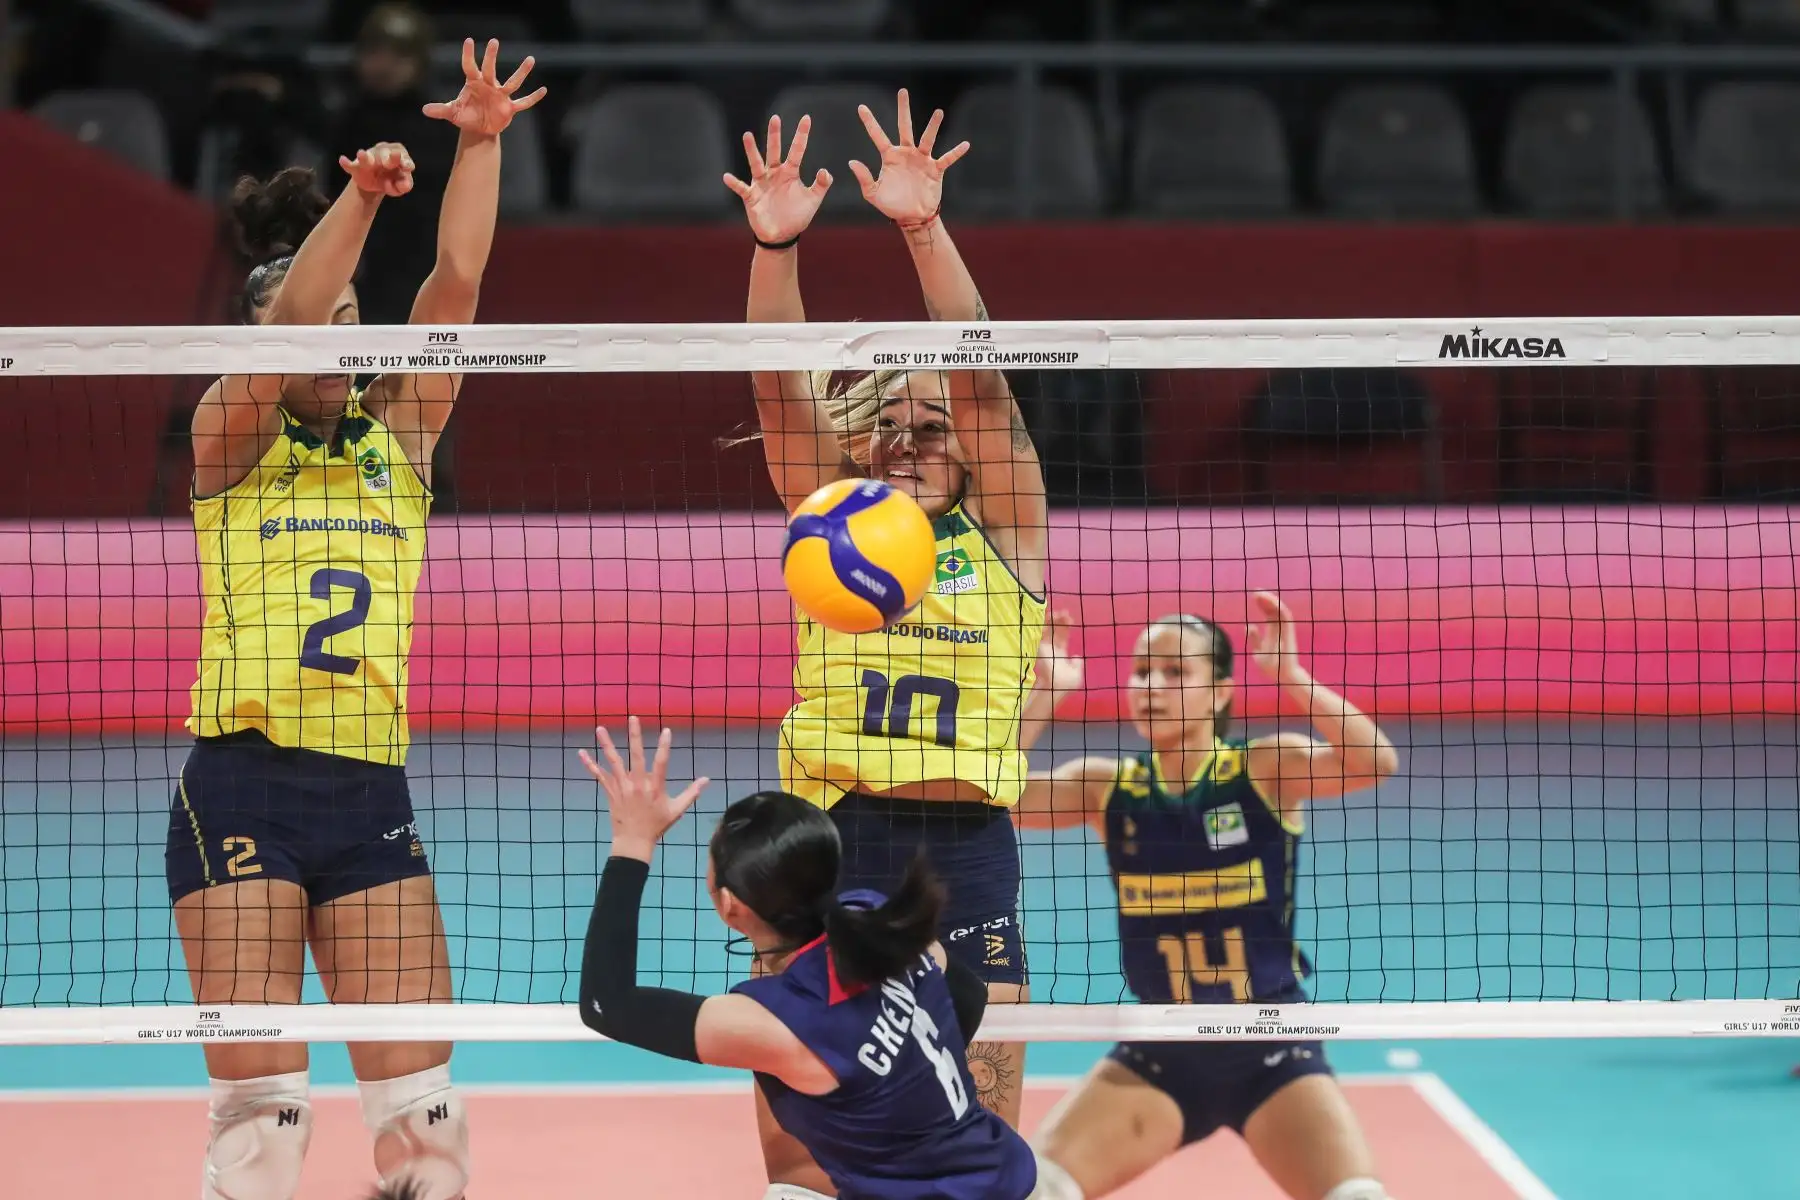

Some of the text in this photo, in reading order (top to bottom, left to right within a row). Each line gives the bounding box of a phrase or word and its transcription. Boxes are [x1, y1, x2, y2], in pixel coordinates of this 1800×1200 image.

[428, 332, 458, 342] FIVB
[961, 329, 992, 340] FIVB
[380, 356, 403, 367] U17
[407, 355, 451, 367] WORLD
[454, 354, 547, 366] CHAMPIONSHIP
[914, 353, 936, 364] U17
[941, 352, 984, 364] WORLD
[987, 352, 1079, 364] CHAMPIONSHIP
[286, 517, 345, 532] BANCO
[348, 519, 369, 534] DO
[937, 575, 978, 594] BRASIL
[300, 567, 372, 675] 2
[912, 625, 934, 639] DO
[937, 625, 988, 644] BRASIL
[861, 669, 960, 749] 10
[223, 836, 263, 877] 2
[1157, 927, 1254, 1004] 14
[199, 1011, 220, 1019] FIVB
[1259, 1009, 1280, 1017] FIVB
[1226, 1026, 1242, 1034] U17
[1244, 1026, 1274, 1034] WORLD
[1276, 1026, 1340, 1034] CHAMPIONSHIP
[1752, 1022, 1767, 1030] U17
[1770, 1022, 1800, 1030] WORLD
[166, 1029, 182, 1038] U17
[185, 1029, 215, 1037] WORLD
[217, 1028, 282, 1037] CHAMPIONSHIP
[911, 1005, 969, 1121] 6
